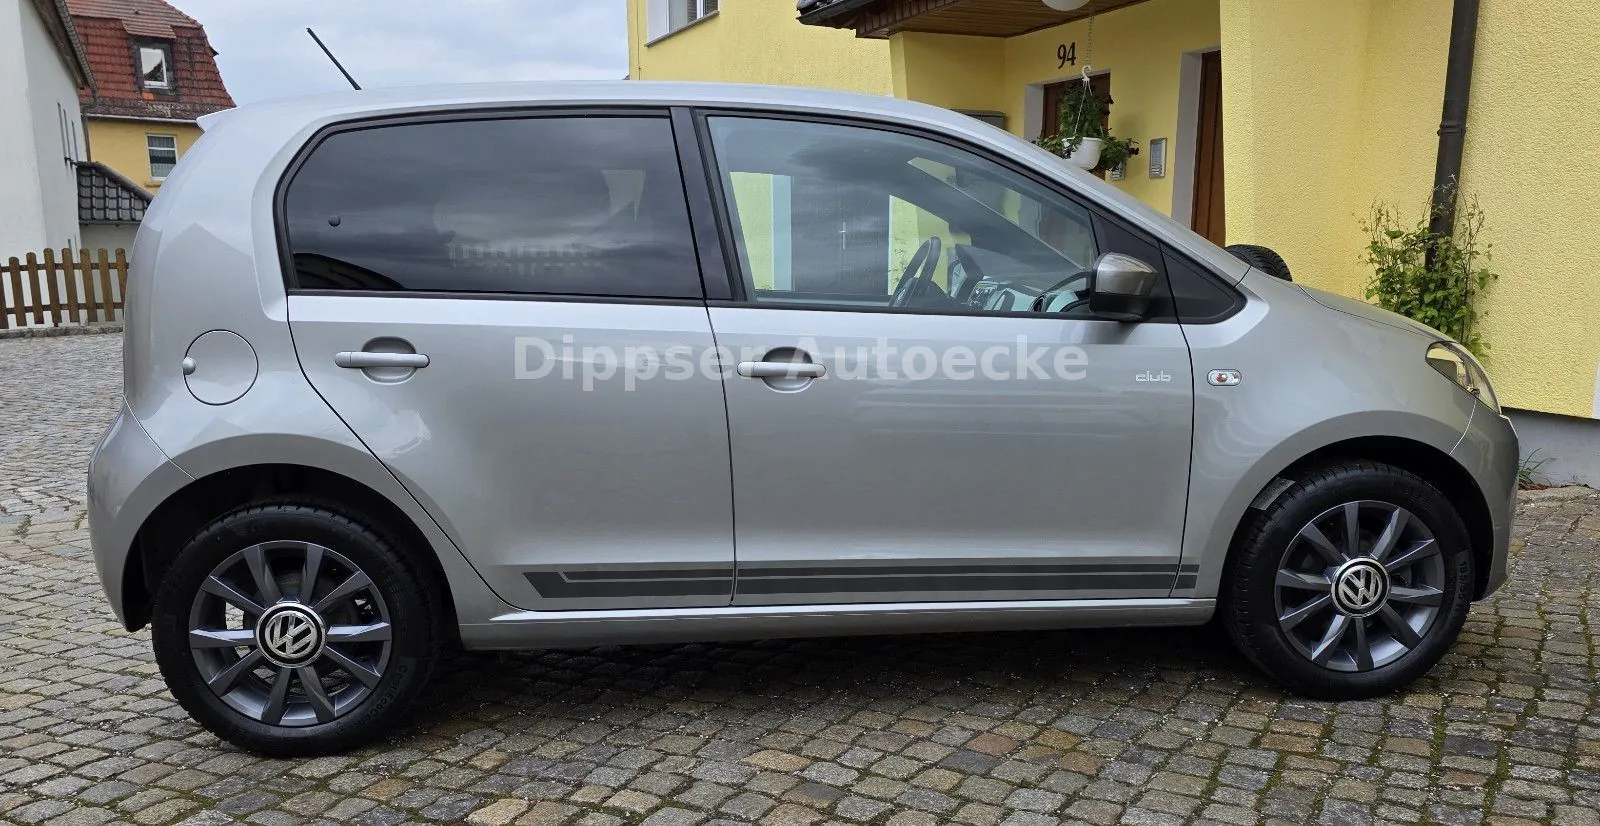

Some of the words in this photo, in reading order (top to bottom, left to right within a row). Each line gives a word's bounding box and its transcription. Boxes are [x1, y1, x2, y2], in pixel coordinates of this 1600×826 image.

[1057, 41, 1077, 69] 94
[1135, 370, 1172, 382] club
[1338, 564, 1383, 610] VW
[265, 610, 318, 659] VW
